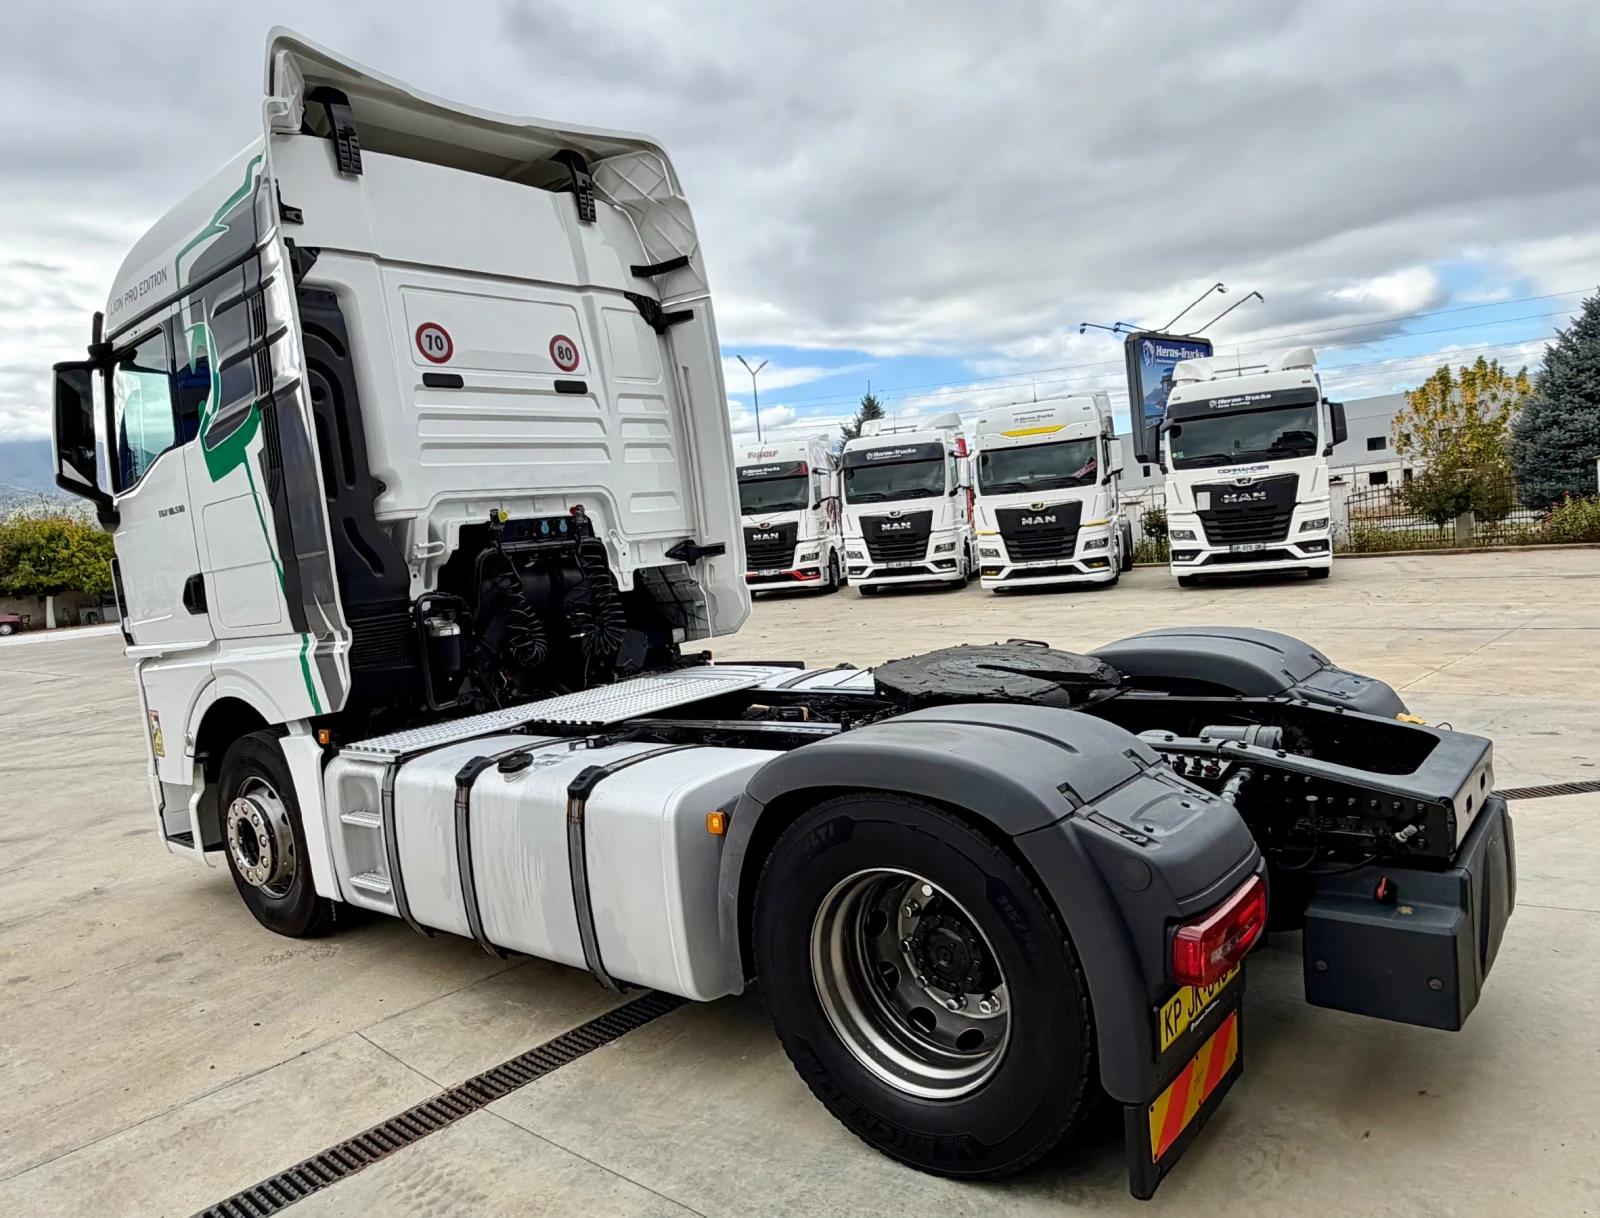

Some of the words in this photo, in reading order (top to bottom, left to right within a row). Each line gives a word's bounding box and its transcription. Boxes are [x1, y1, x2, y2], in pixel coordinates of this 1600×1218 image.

[124, 286, 138, 306] PRO
[139, 266, 168, 297] EDITION
[425, 334, 444, 352] 70
[557, 345, 573, 361] 80
[1155, 345, 1205, 359] Heros-Trucks
[1223, 491, 1267, 504] MAN
[880, 521, 911, 531] MAN
[1021, 515, 1057, 526] MAN
[752, 532, 779, 541] MAN
[1164, 997, 1182, 1044] KP
